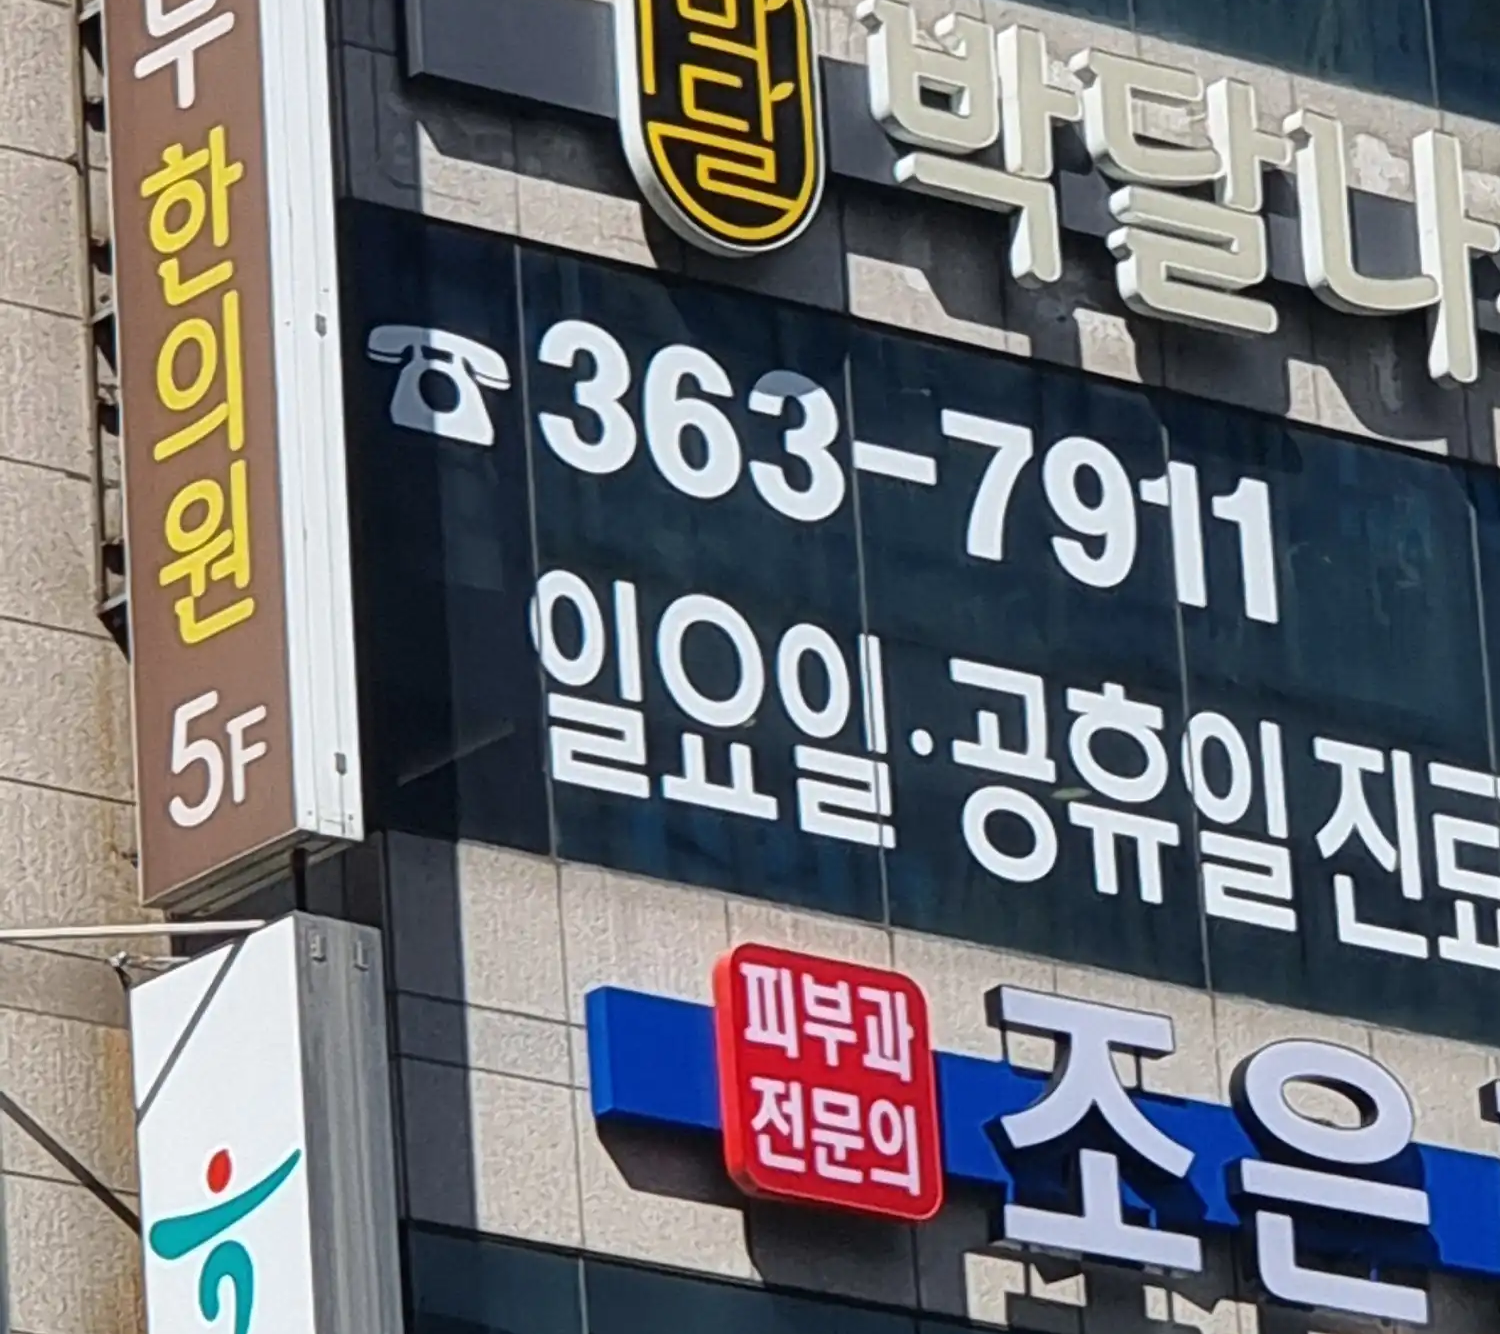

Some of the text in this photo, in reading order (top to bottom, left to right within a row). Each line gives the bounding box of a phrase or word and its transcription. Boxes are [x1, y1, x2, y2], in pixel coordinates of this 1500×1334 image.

[536, 319, 1280, 625] 363-7911
[169, 689, 268, 828] 5F
[738, 961, 915, 1083] 피부과
[750, 1076, 920, 1198] 전문의
